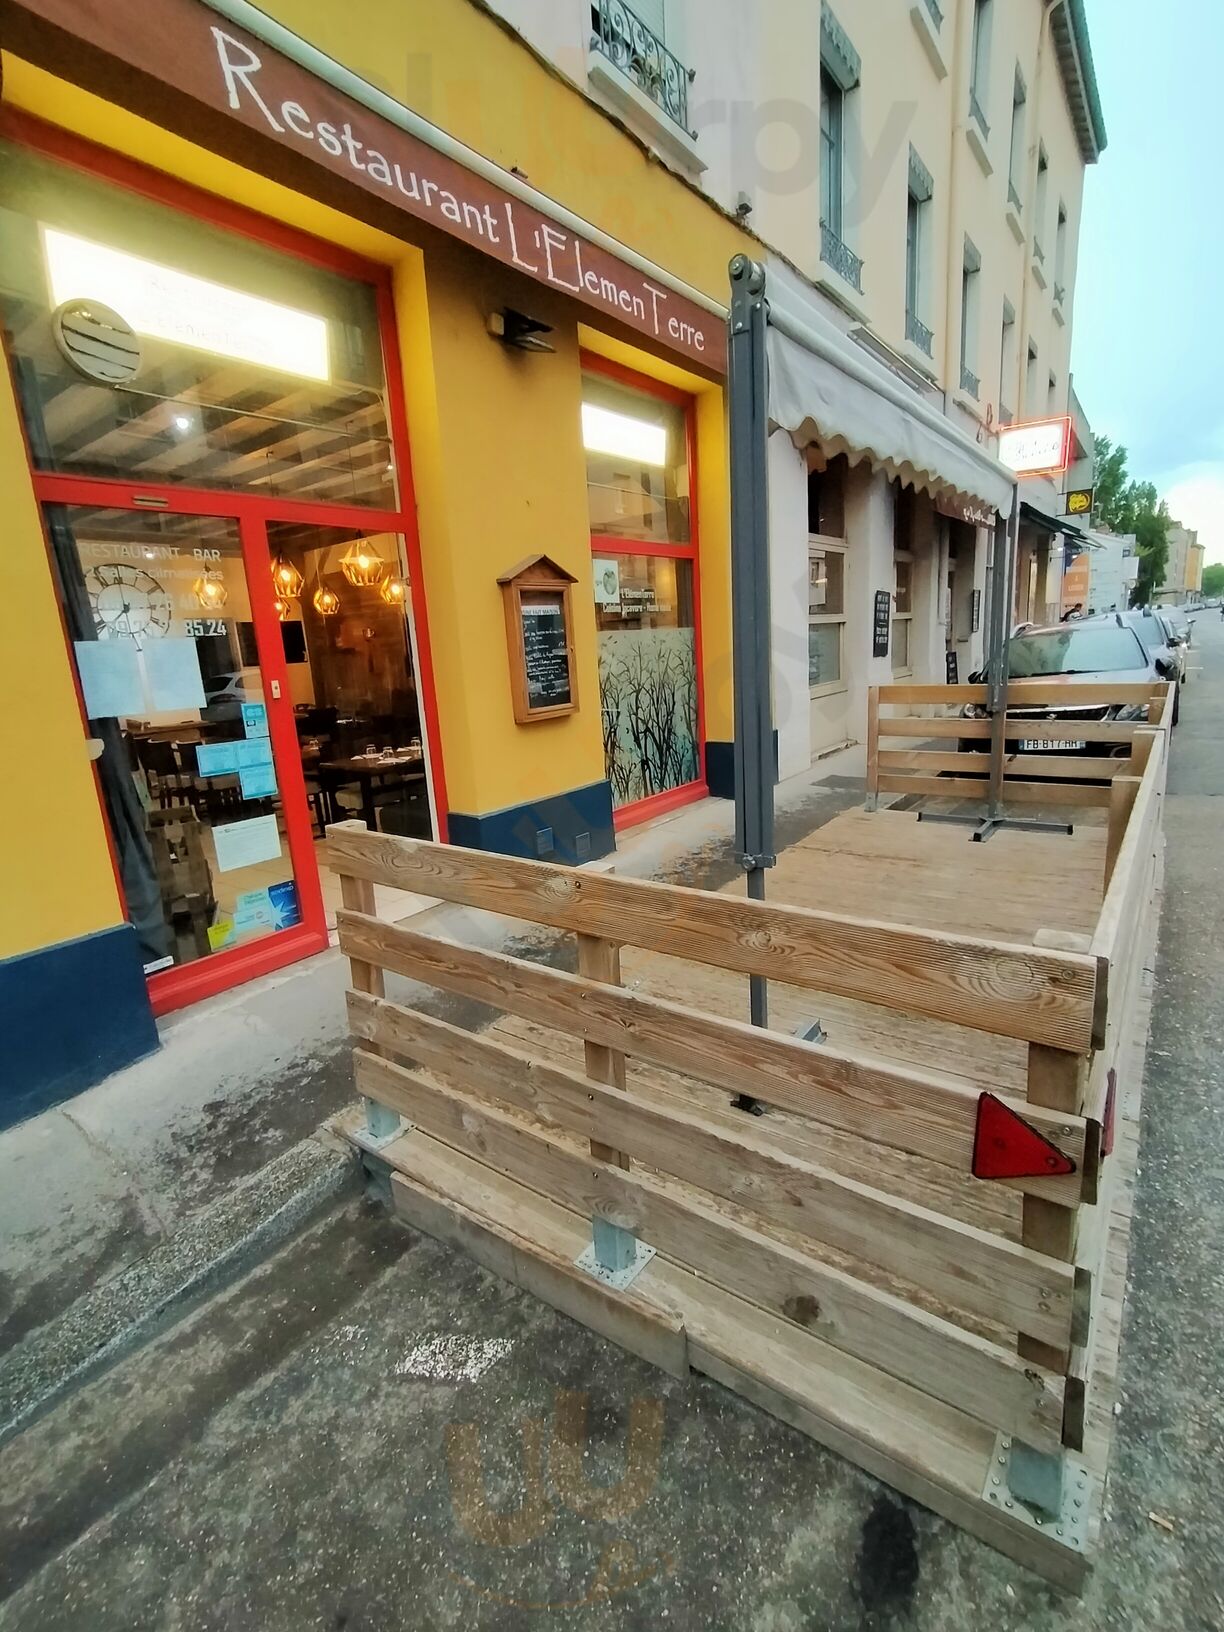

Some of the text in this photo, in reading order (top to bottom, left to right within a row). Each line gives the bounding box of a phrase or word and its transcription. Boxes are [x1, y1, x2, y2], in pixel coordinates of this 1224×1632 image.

[210, 26, 500, 243] Restaurant
[78, 542, 181, 561] RESTAURANT
[193, 547, 222, 562] BAR
